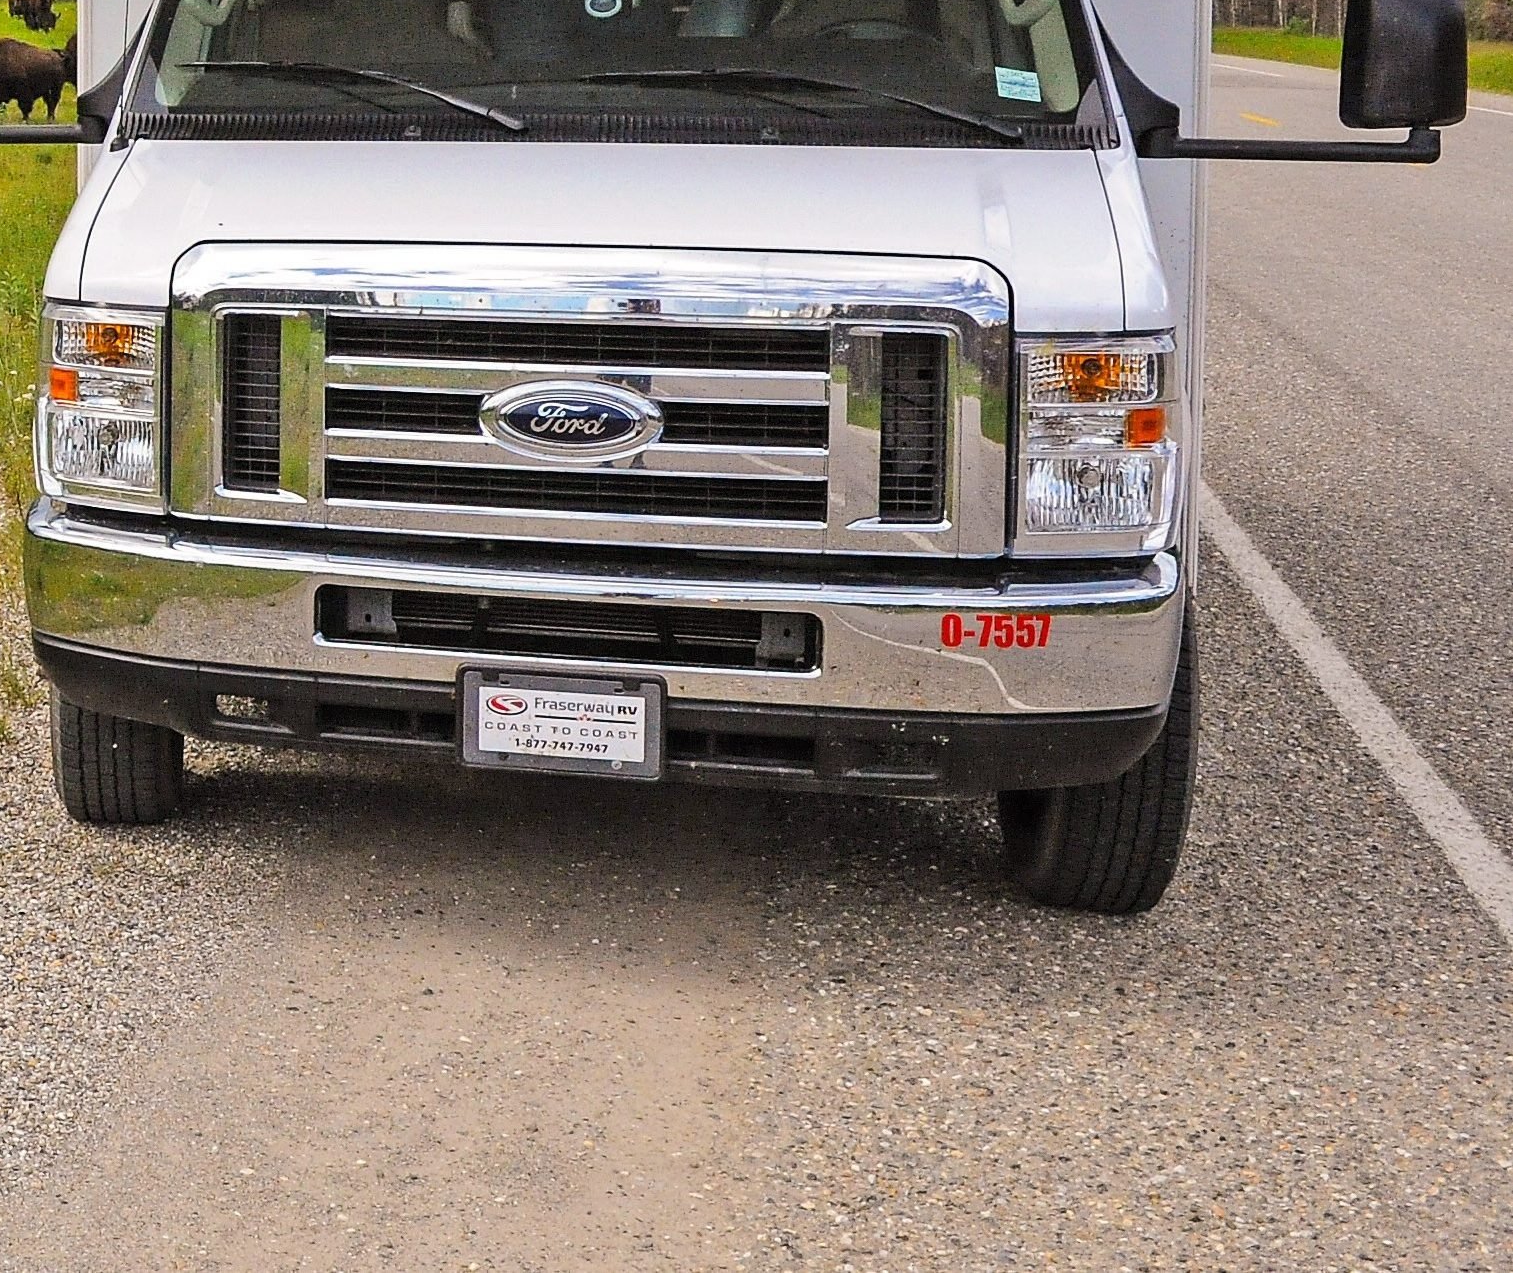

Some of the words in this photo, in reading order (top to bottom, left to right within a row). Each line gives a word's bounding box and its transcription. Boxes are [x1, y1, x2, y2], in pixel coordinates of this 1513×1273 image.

[530, 402, 609, 435] Ford
[534, 697, 614, 716] Fraserway
[617, 705, 638, 715] RV
[484, 721, 542, 734] COAST
[551, 726, 572, 736] TO
[579, 728, 639, 740] COAST
[515, 738, 608, 753] 1-877-747-7947
